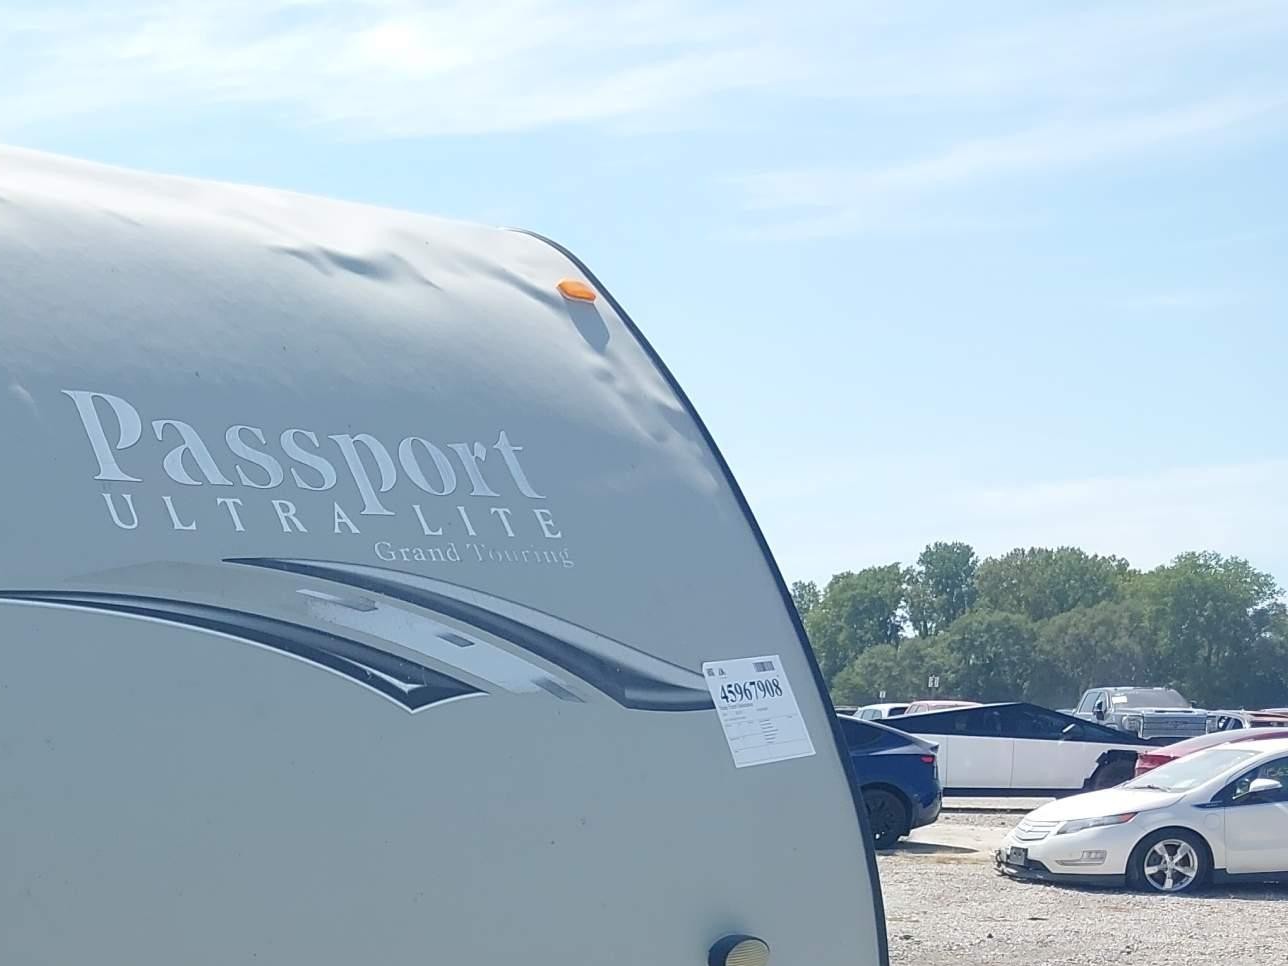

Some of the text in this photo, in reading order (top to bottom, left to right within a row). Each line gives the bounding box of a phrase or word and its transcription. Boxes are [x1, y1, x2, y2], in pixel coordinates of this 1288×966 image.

[61, 389, 547, 516] Passport
[100, 493, 563, 539] ULTRA LITE
[373, 541, 575, 568] Grand Touring
[720, 678, 783, 703] 45967908
